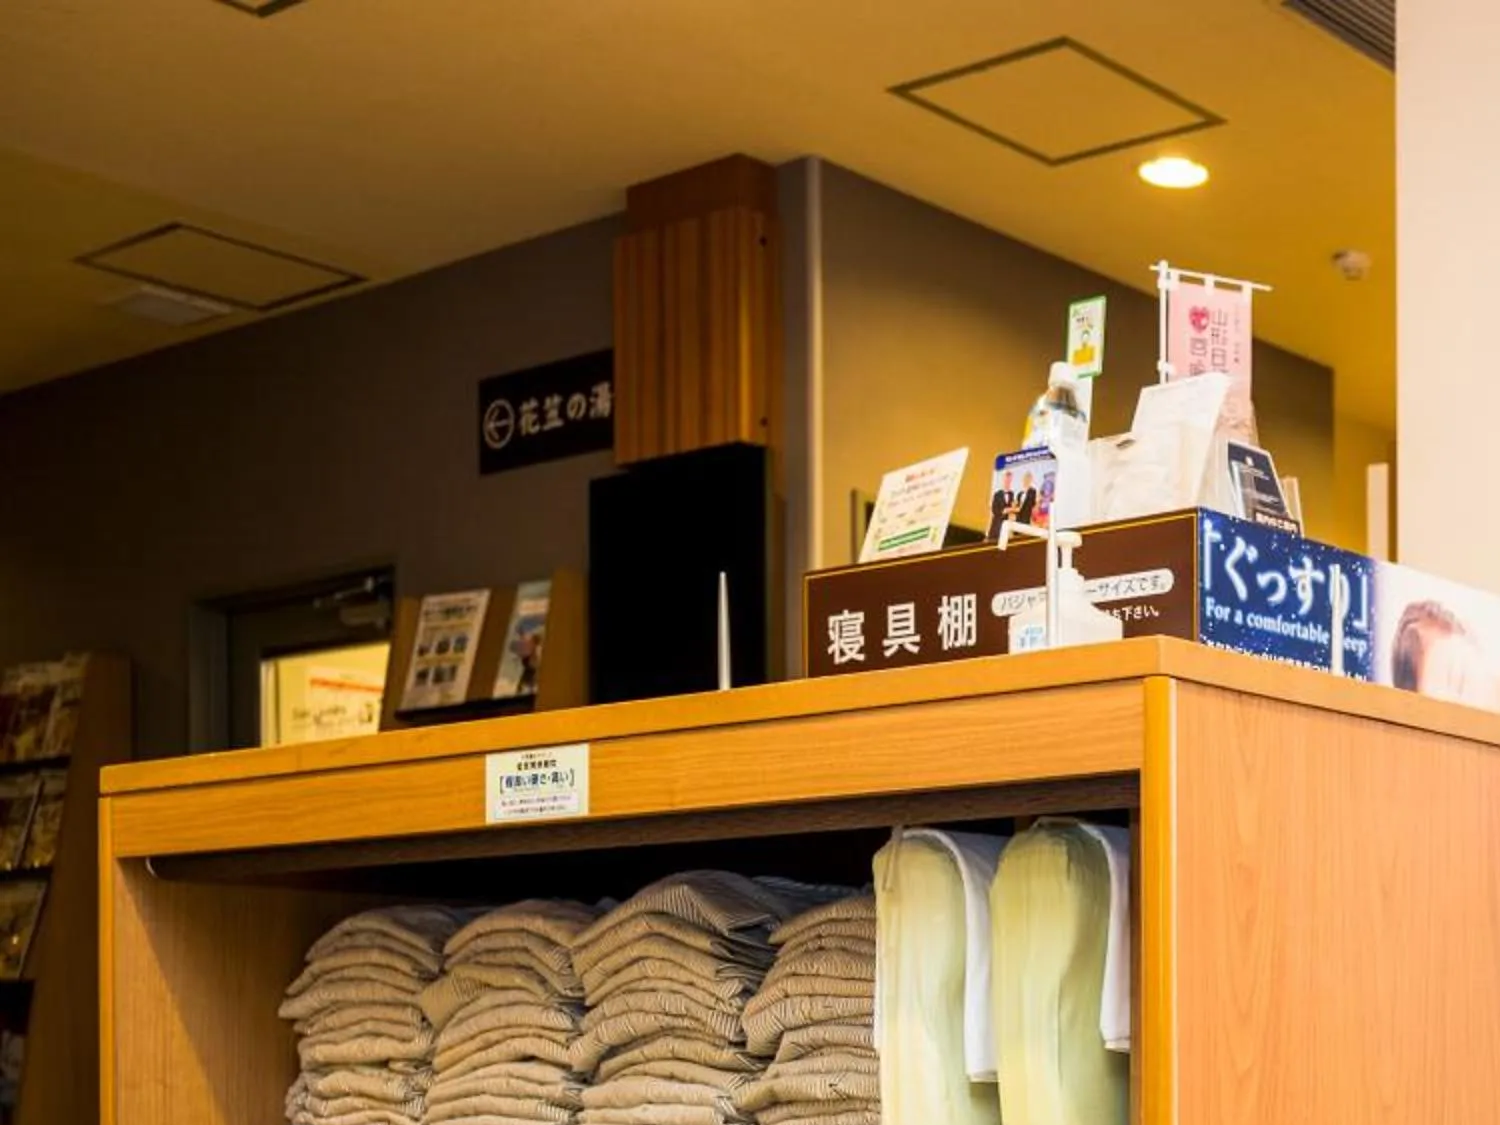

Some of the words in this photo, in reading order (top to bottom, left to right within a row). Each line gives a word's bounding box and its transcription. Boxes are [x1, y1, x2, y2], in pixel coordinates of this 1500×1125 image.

[827, 593, 977, 665] 寝具棚
[1205, 596, 1231, 622] For
[1234, 609, 1243, 625] a
[1246, 611, 1330, 645] comfortable
